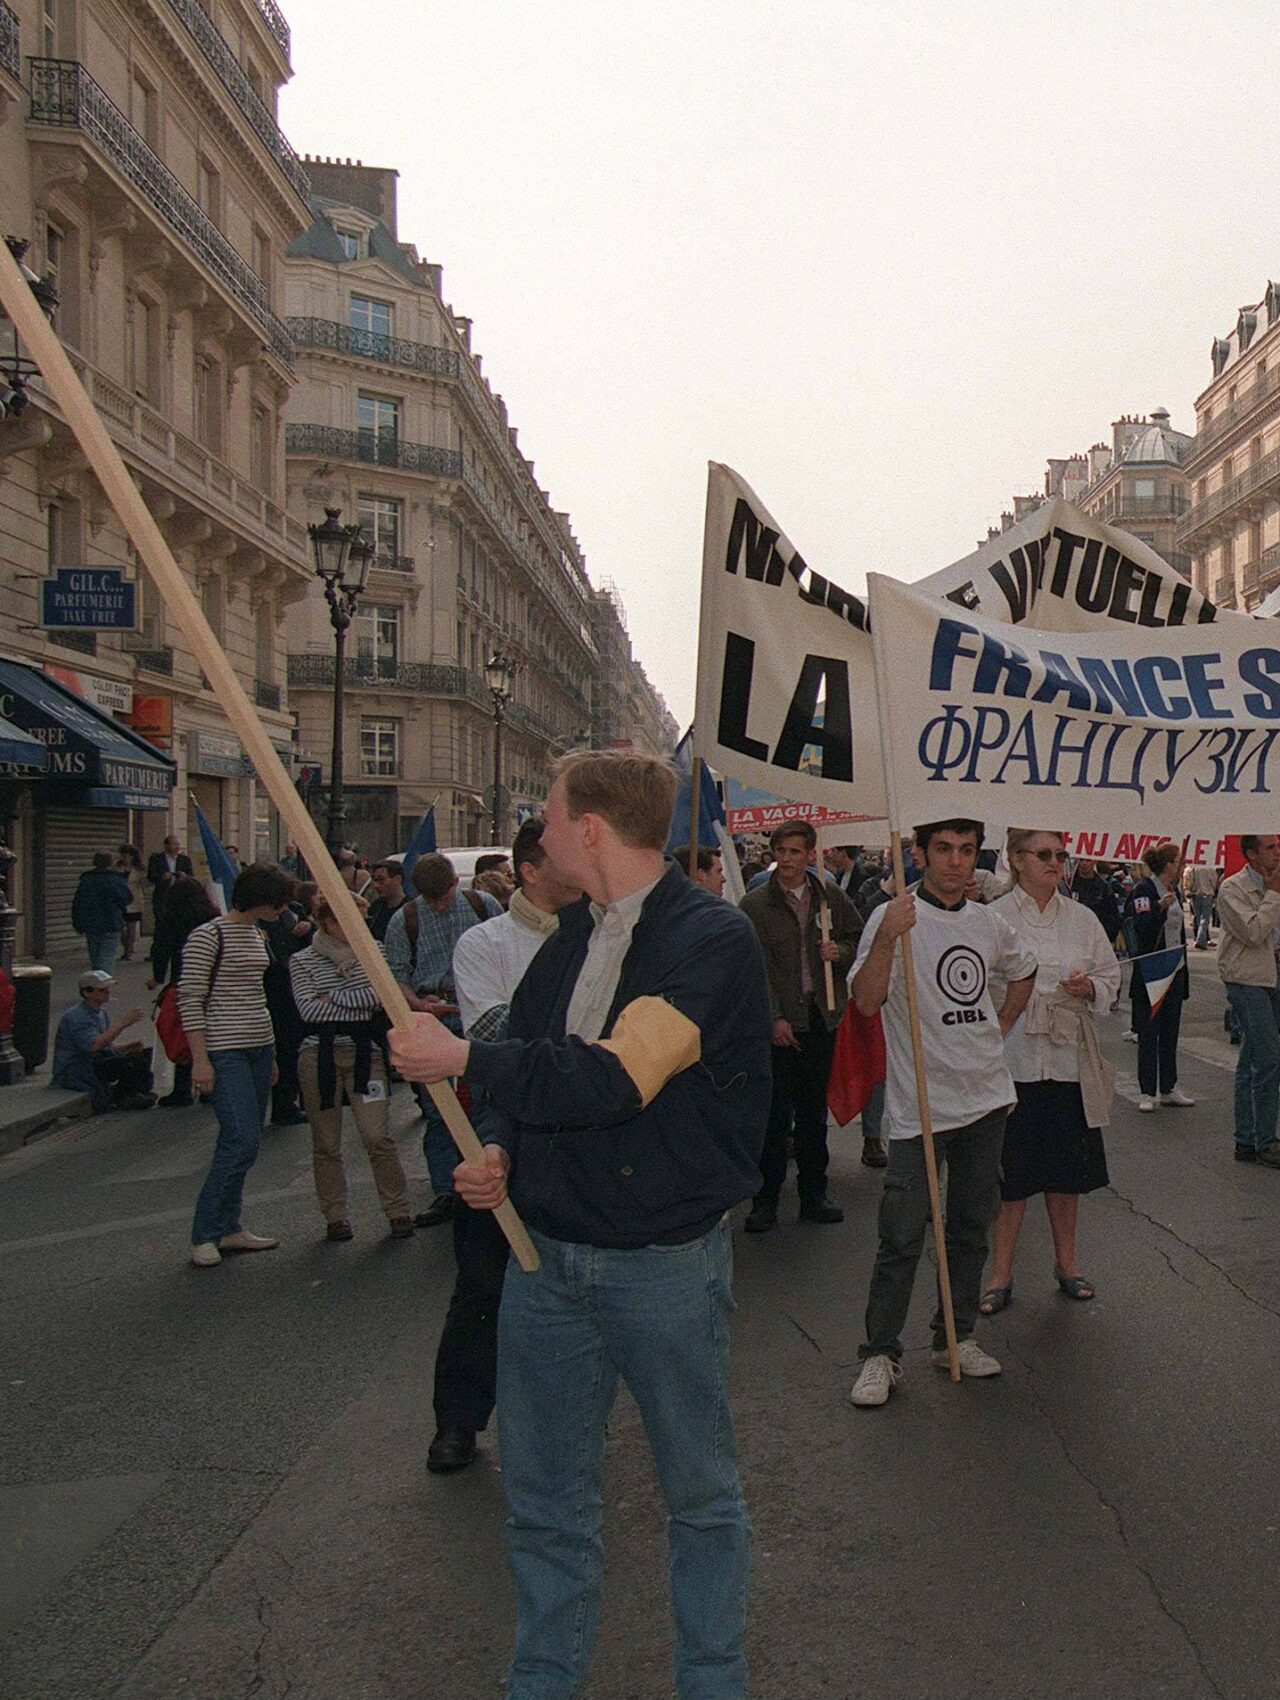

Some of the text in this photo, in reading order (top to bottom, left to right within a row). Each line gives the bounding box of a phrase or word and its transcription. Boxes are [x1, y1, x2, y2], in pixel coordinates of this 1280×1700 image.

[55, 593, 124, 609] PARFUMERIE
[92, 610, 116, 623] FREE
[929, 617, 1234, 720] FRANCE
[717, 630, 853, 783] LA
[105, 764, 169, 791] PARFUMERIE
[733, 811, 754, 822] LA
[762, 803, 819, 820] VAGUE
